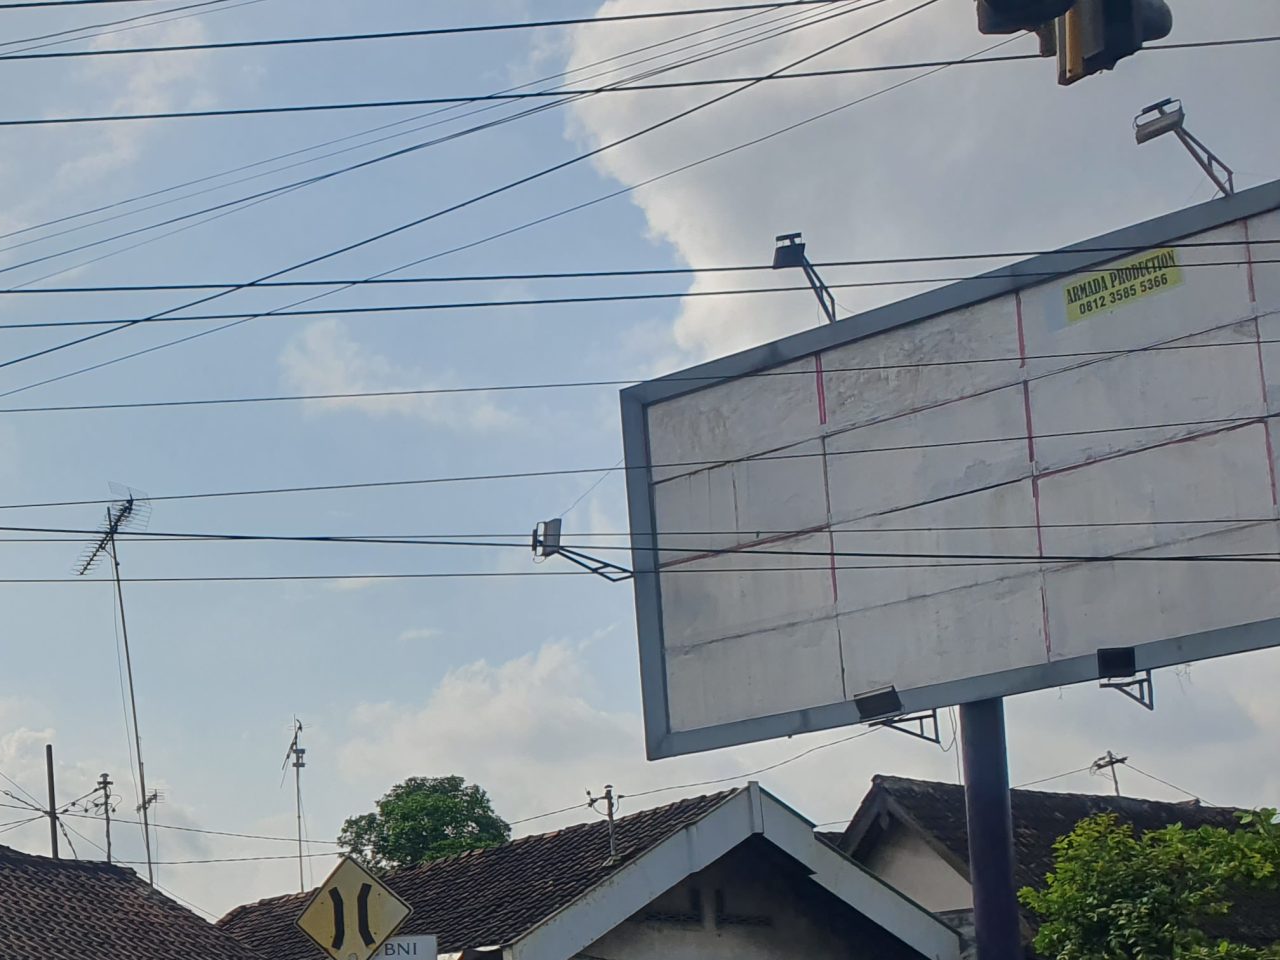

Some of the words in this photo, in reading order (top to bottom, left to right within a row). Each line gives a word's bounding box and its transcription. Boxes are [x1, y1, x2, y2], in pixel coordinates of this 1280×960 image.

[1066, 275, 1109, 305] ARMADA
[1109, 250, 1177, 289] PRODUCTION
[1079, 296, 1107, 315] 0812
[1109, 284, 1138, 304] 3585
[1139, 273, 1168, 293] 5366
[384, 942, 417, 956] BNI
